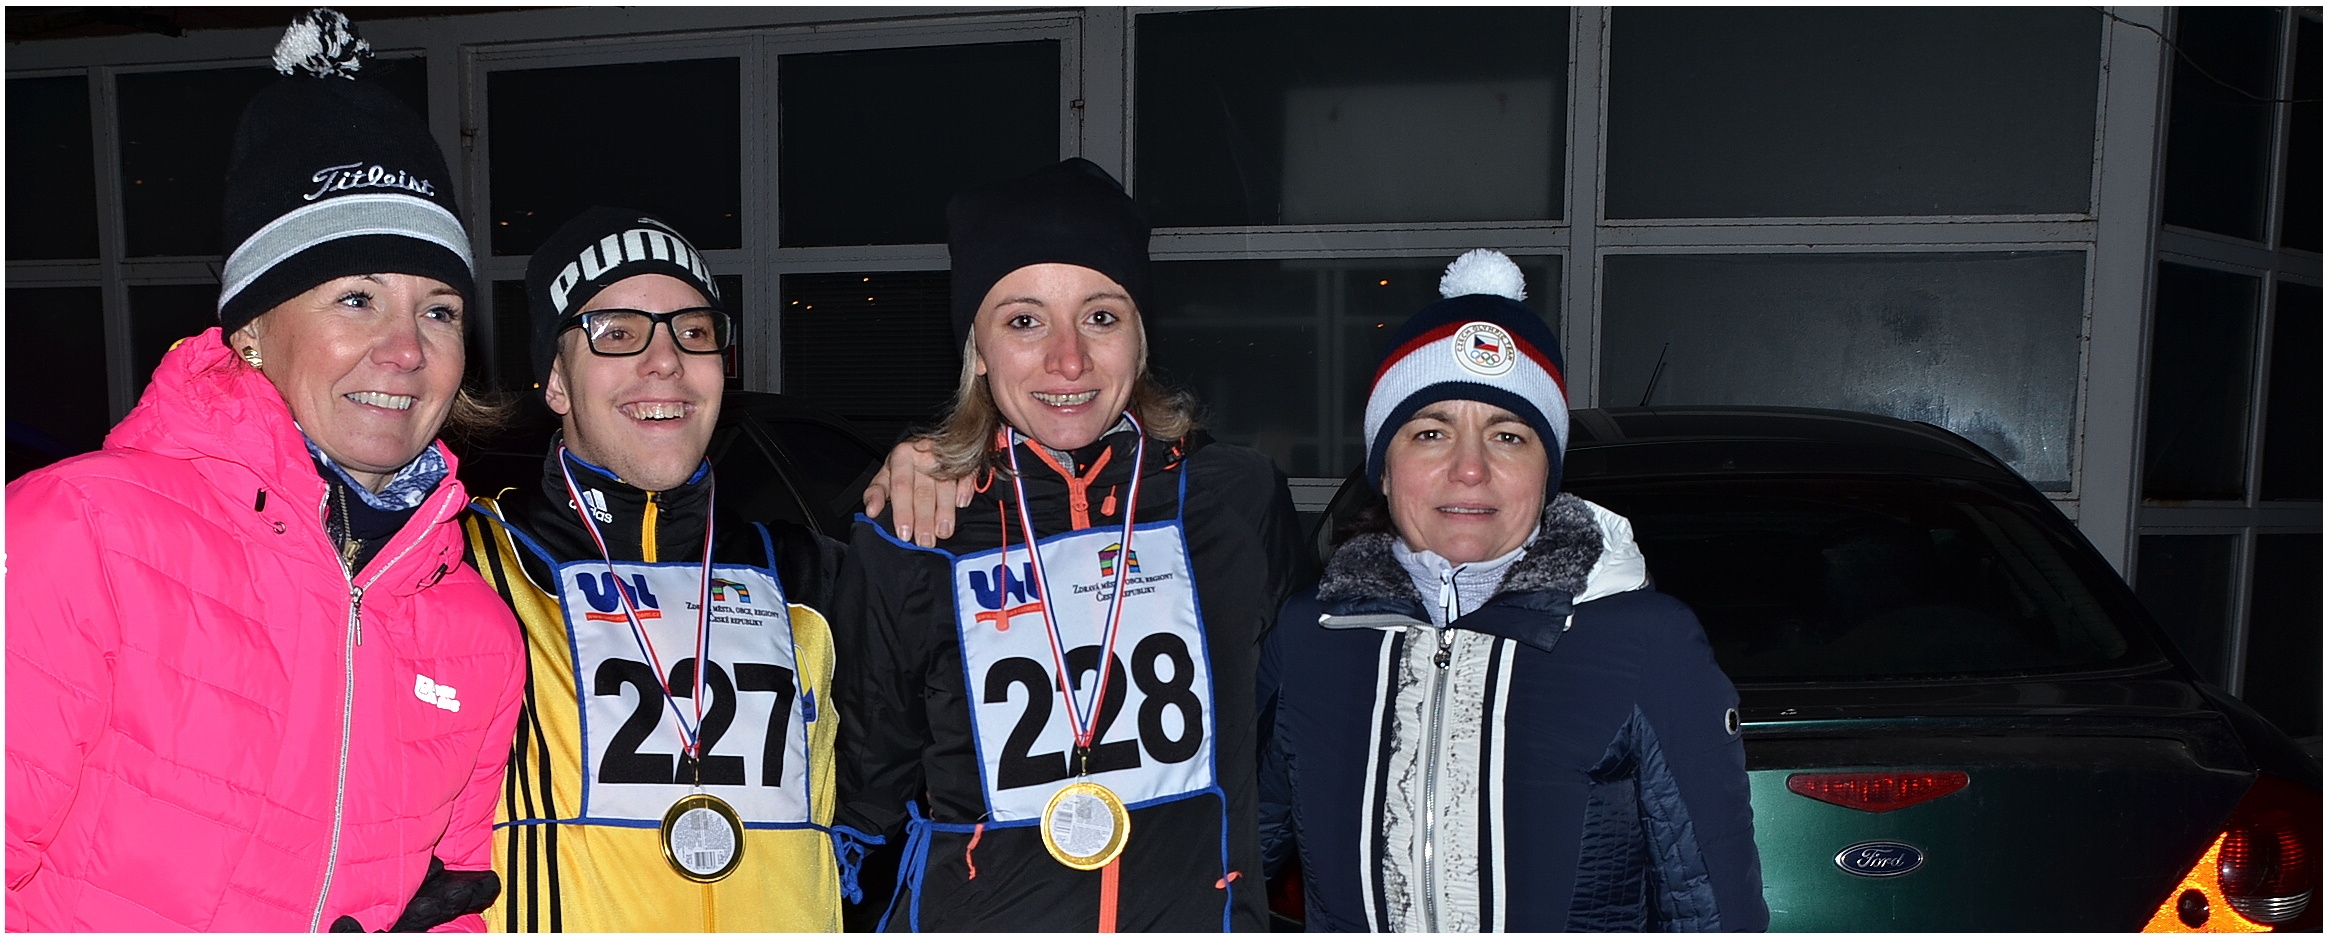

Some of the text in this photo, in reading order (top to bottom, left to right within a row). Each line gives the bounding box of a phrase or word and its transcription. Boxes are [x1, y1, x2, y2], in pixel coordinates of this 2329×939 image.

[303, 161, 435, 200] Titleist
[550, 229, 718, 315] PUMA
[1457, 330, 1471, 352] CZECH
[594, 657, 797, 787] 227
[983, 632, 1204, 791] 228
[1856, 848, 1905, 868] Ford
